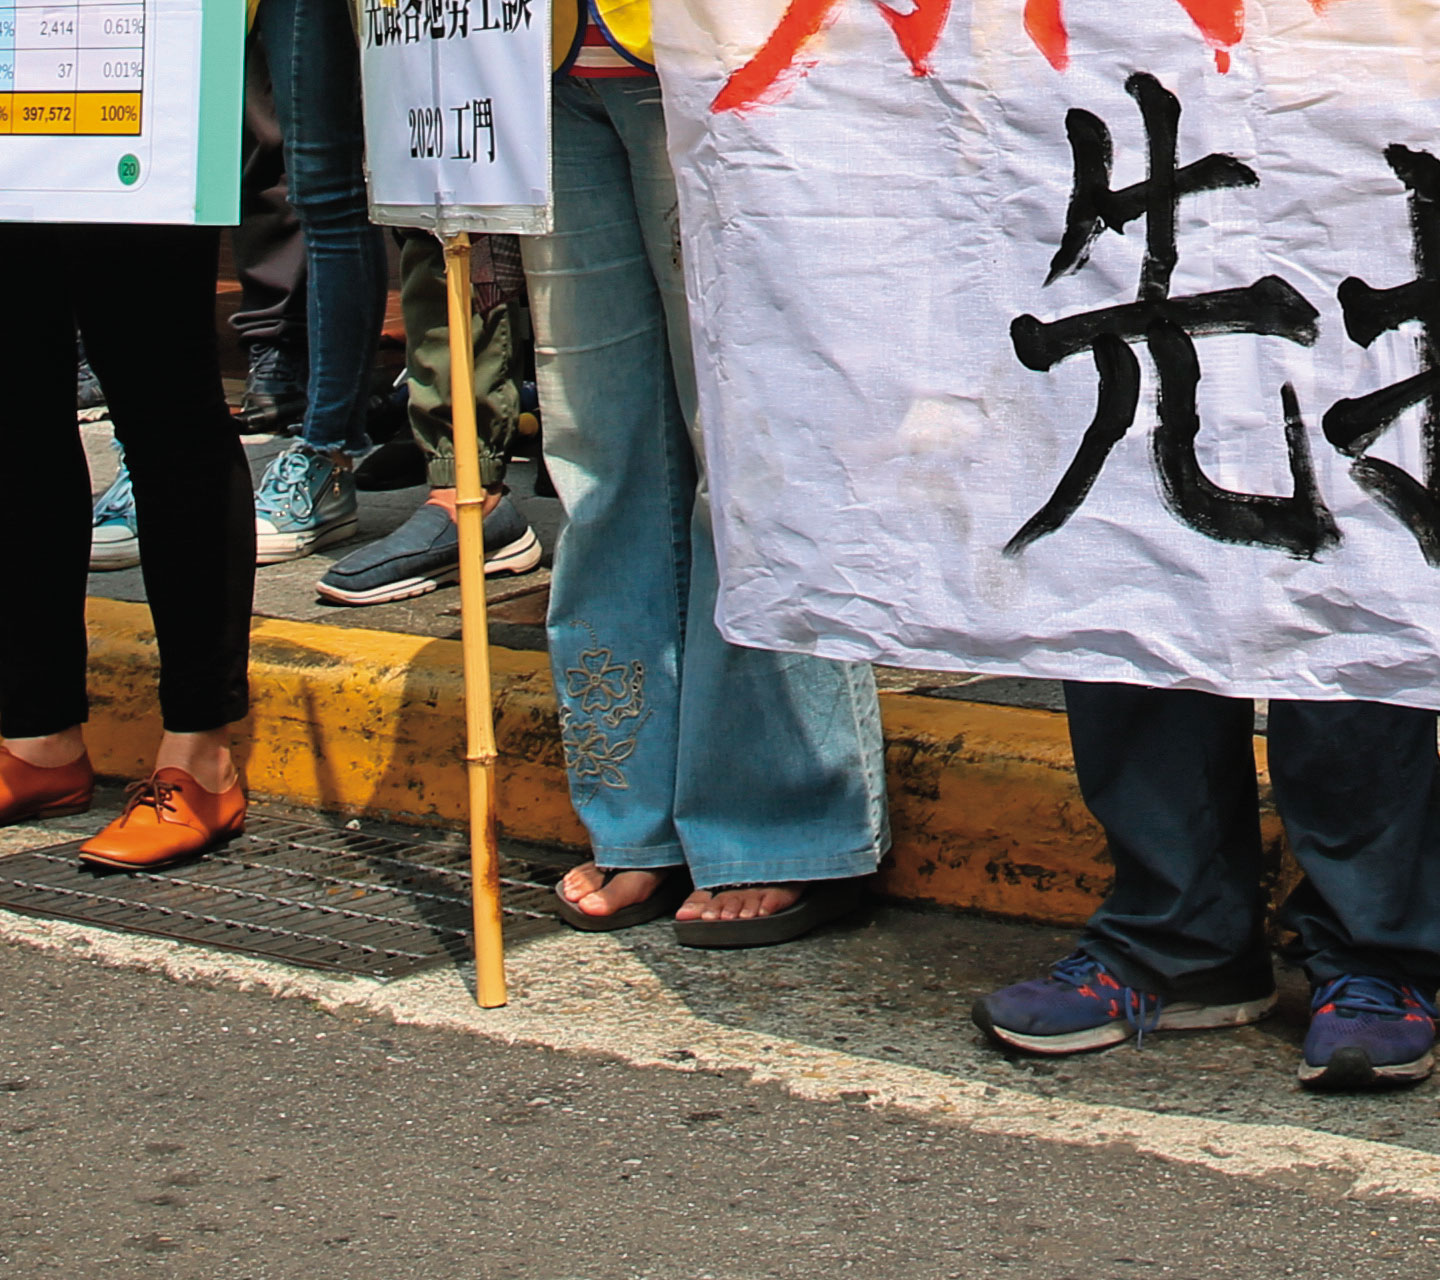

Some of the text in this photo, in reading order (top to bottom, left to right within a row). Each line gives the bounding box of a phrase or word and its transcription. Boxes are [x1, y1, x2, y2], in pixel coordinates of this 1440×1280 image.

[40, 21, 74, 37] 2,414
[104, 18, 144, 35] 0.61%
[58, 62, 73, 78] 37
[103, 60, 143, 79] 0.01%
[23, 106, 72, 122] 397,572
[101, 105, 138, 122] 100%
[409, 106, 442, 159] 2020
[123, 162, 136, 177] 20
